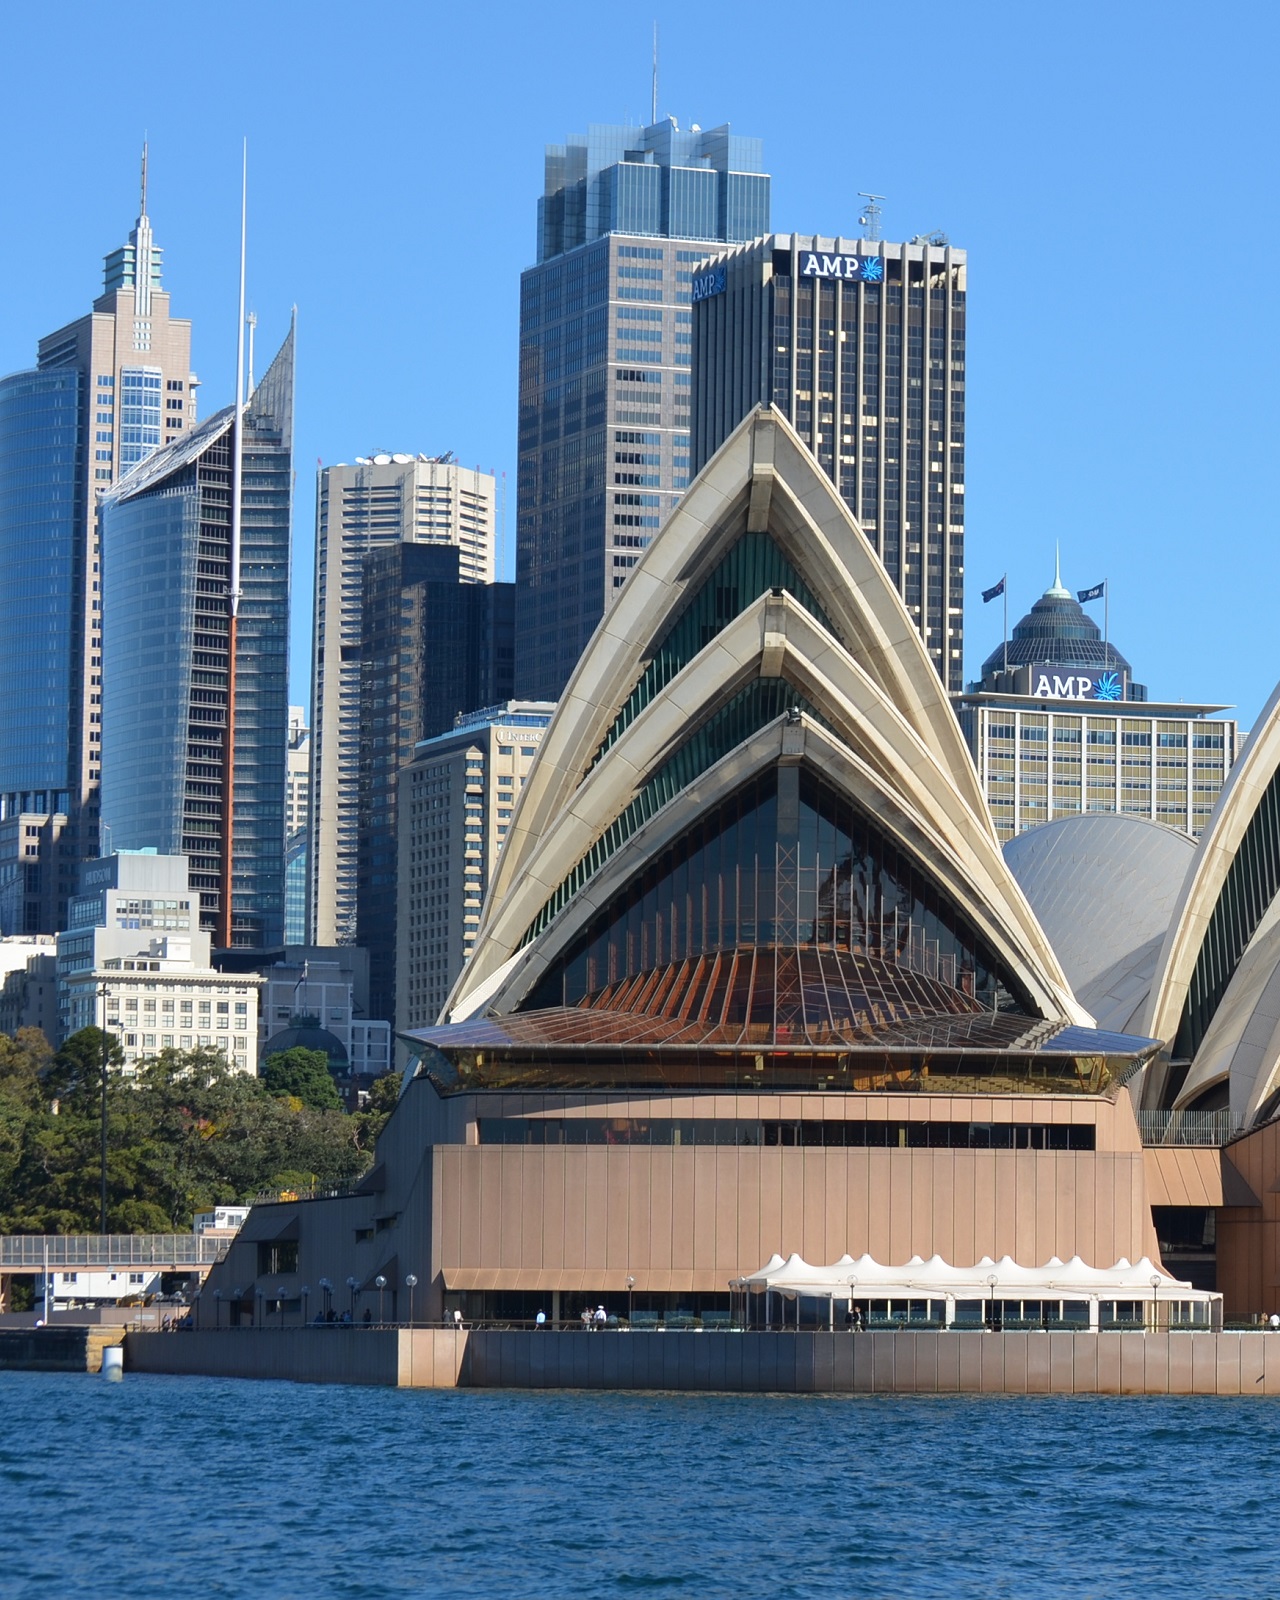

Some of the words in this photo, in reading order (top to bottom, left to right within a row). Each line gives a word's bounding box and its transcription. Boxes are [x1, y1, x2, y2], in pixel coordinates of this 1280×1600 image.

[803, 253, 859, 278] AMP
[693, 274, 715, 300] AMP
[1034, 674, 1092, 699] AMP
